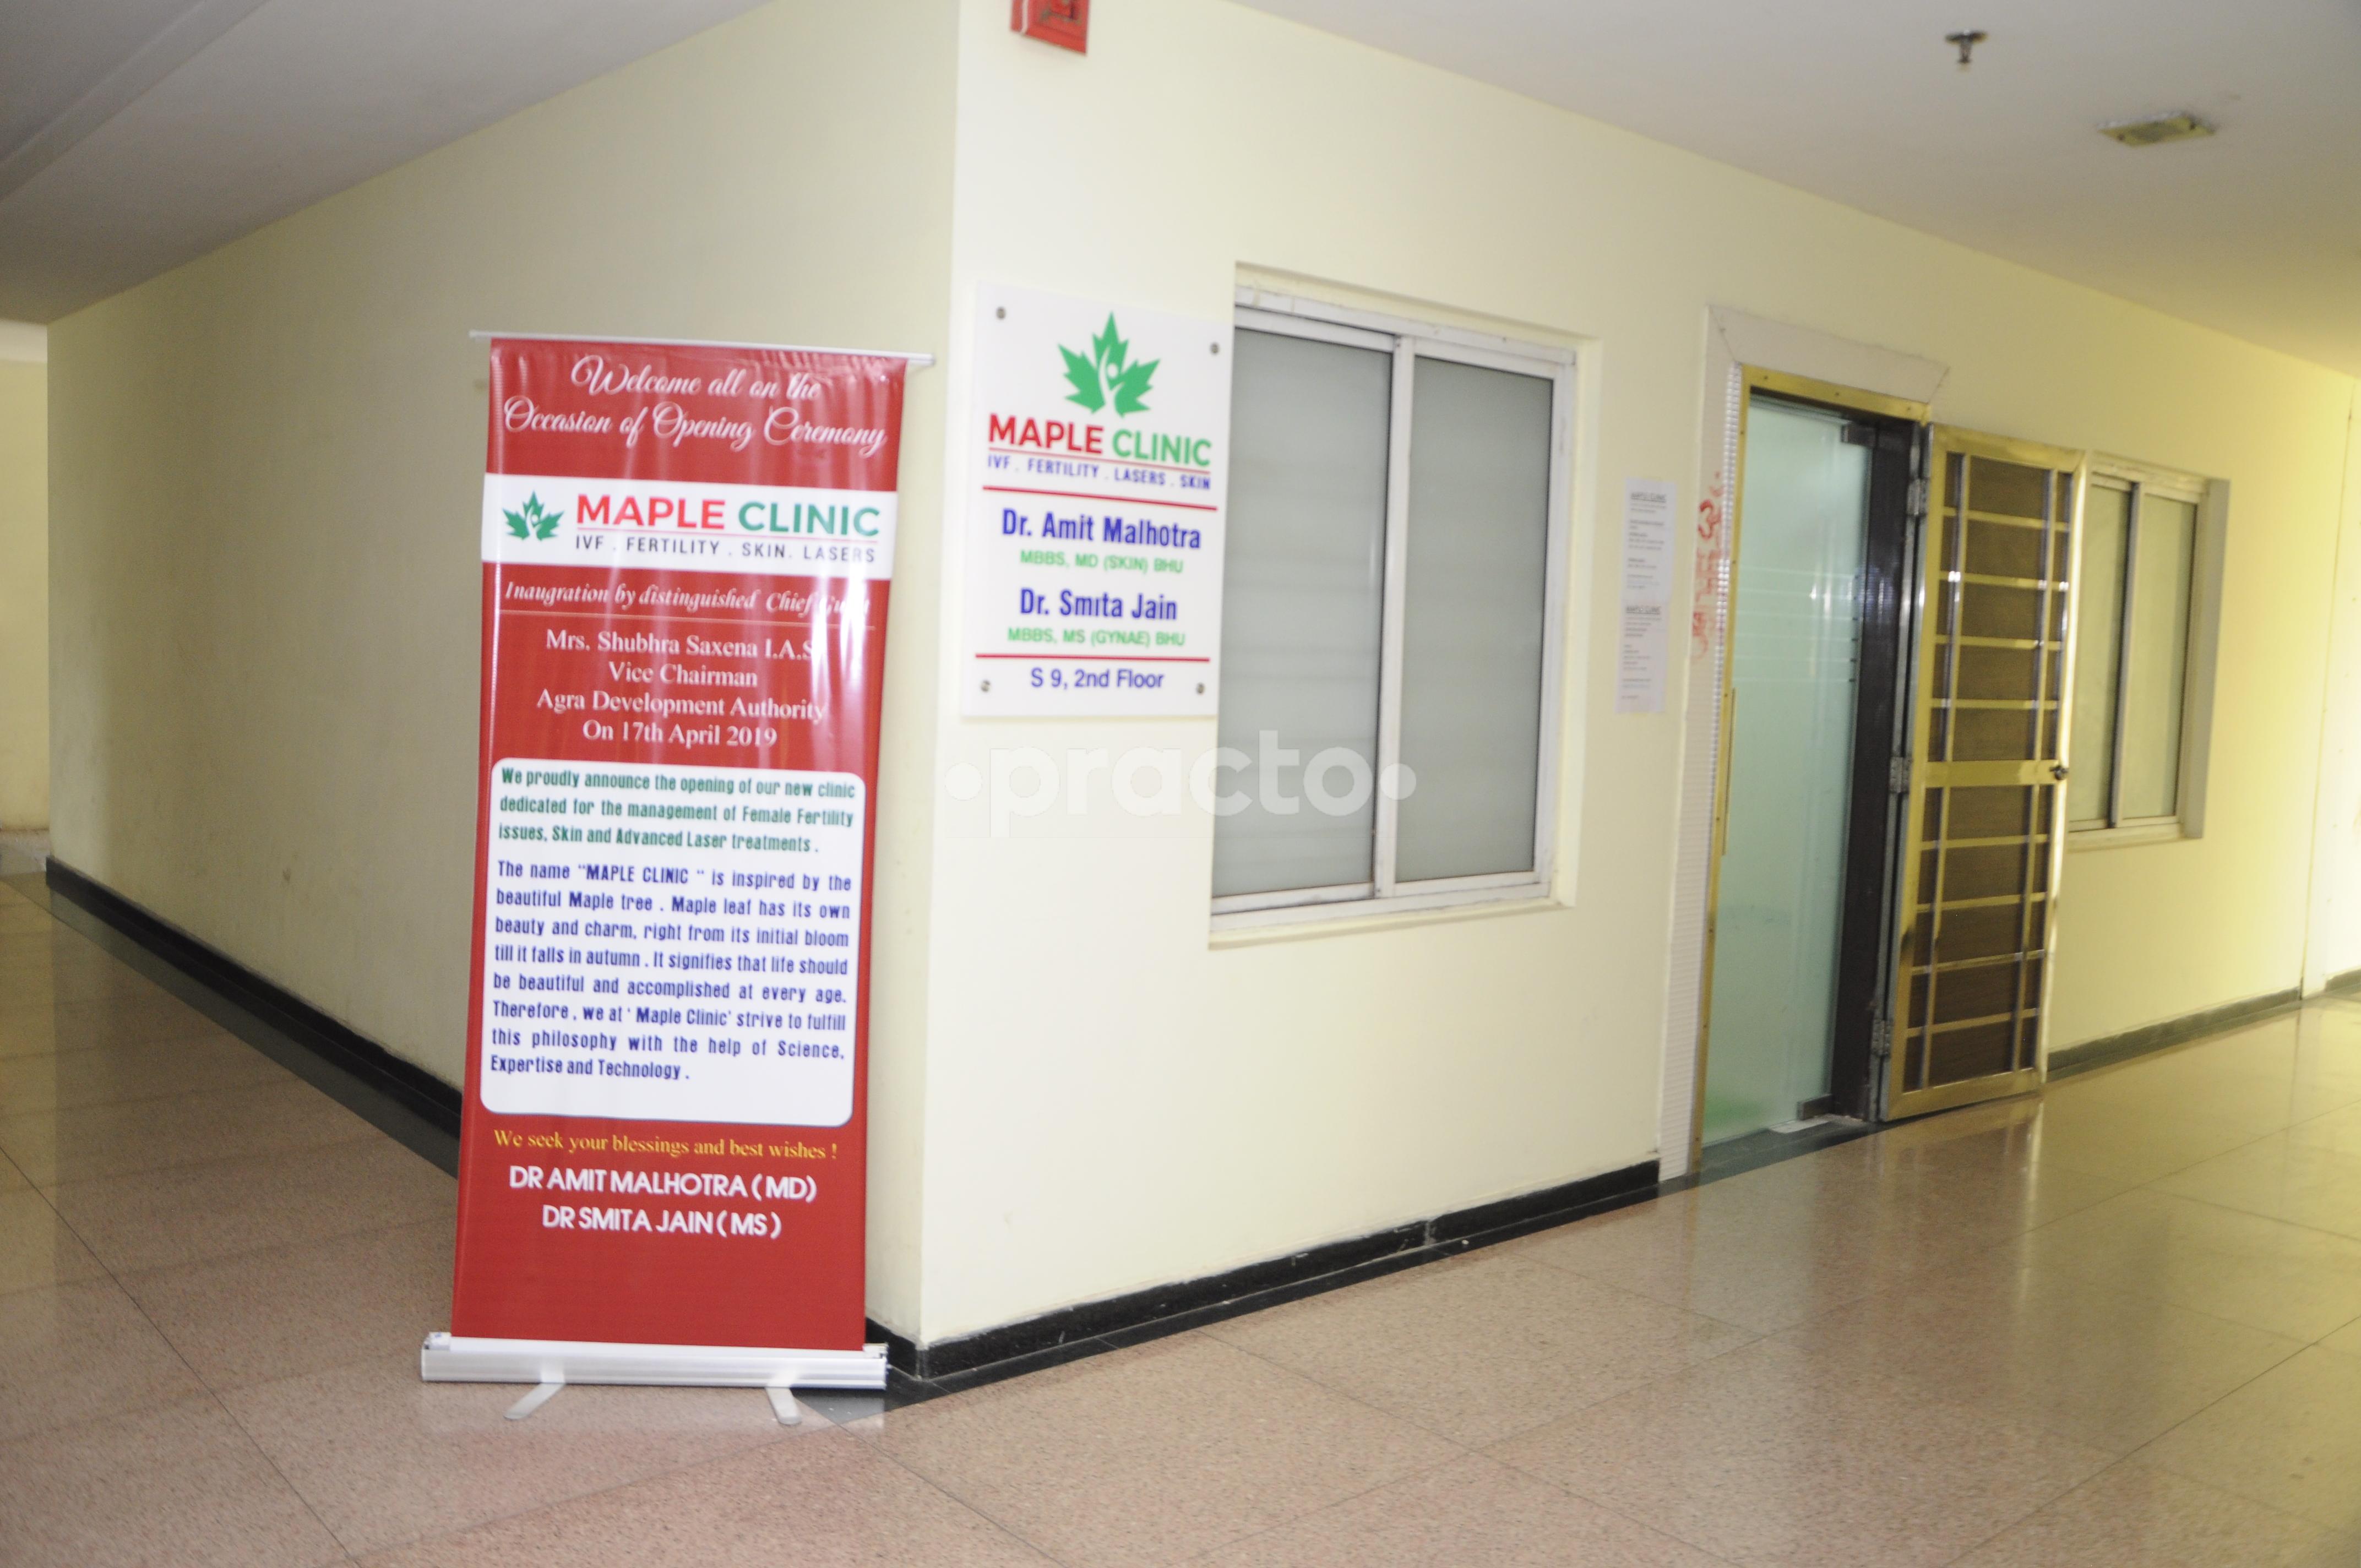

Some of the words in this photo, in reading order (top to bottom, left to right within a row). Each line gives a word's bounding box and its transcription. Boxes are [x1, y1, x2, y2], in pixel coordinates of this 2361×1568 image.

[571, 355, 701, 396] Welcome
[708, 369, 742, 396] all
[750, 378, 778, 397] on
[787, 373, 820, 400] the
[504, 395, 612, 434] Occasion
[620, 407, 646, 448] of
[652, 401, 754, 451] Opening
[763, 405, 888, 458] Ceremony
[988, 413, 1105, 454] MAPLE
[1112, 429, 1212, 466] CLINIC
[987, 455, 1011, 471] IVF
[1028, 458, 1100, 480] FERTILITY
[1114, 467, 1166, 486] LASERS
[1180, 473, 1211, 490] SKIN
[576, 494, 726, 530] MAPLE
[738, 502, 880, 537] CLINIC
[1002, 509, 1031, 537] Dr.
[1042, 512, 1095, 541] Amit
[1102, 516, 1202, 548] Malhotra
[575, 535, 604, 552] IVF
[627, 537, 719, 556] FERTILITY
[803, 546, 875, 563] LASERS
[1075, 554, 1098, 568] MD
[1104, 555, 1149, 574] (SKIN)
[1154, 558, 1183, 573] BHU
[505, 582, 609, 608] Inaugration
[614, 584, 637, 609] by
[639, 585, 757, 609] distinguished
[766, 590, 813, 615] Chief
[1020, 589, 1049, 615] Dr.
[1131, 593, 1177, 620] Jain
[546, 630, 590, 651] Mrs.
[597, 632, 680, 654] Shubhra
[686, 635, 757, 657] Saxena
[1063, 629, 1086, 643] MS
[1156, 632, 1185, 646] BHU
[609, 662, 653, 683] Vice
[660, 663, 757, 687] Chairman
[1031, 668, 1044, 688] S
[1074, 669, 1109, 688] 2nd
[1117, 669, 1164, 689] Floor
[537, 690, 585, 715] Agra
[592, 692, 725, 716] Development
[731, 698, 826, 723] Authority
[583, 720, 613, 740] On
[623, 722, 662, 742] 17th
[669, 725, 720, 748] April
[727, 727, 776, 747] 2019
[502, 767, 522, 784] We
[526, 770, 579, 788] proudly
[585, 774, 650, 790] announce
[655, 775, 676, 791] the
[681, 778, 734, 794] opening
[739, 778, 752, 793] of
[757, 782, 780, 794] our
[785, 783, 813, 796] new
[819, 783, 855, 798] clinic
[500, 796, 567, 814] dedicated
[574, 798, 594, 814] for
[602, 800, 622, 816] the
[628, 804, 717, 820] management
[723, 806, 736, 820] of
[743, 806, 791, 823] Female
[798, 809, 853, 827] Fertility
[552, 825, 582, 842] Skin
[587, 828, 611, 843] and
[616, 828, 683, 846] Advanced
[687, 831, 727, 848] Laser
[732, 834, 810, 852] treatments
[498, 860, 523, 877] The
[530, 864, 570, 879] name
[643, 867, 688, 884] CLINIC
[712, 870, 724, 886] is
[732, 872, 795, 890] inspired
[803, 874, 819, 891] by
[829, 875, 851, 891] the
[496, 888, 561, 907] beautiful
[569, 891, 613, 911] Maple
[621, 894, 652, 911] tree
[672, 896, 716, 916] Maple
[724, 899, 751, 914] leaf
[759, 900, 785, 916] has
[793, 902, 811, 917] its
[820, 905, 850, 918] own
[496, 916, 545, 936] beauty
[552, 919, 578, 935] and
[644, 924, 681, 941] right
[689, 925, 724, 941] from
[731, 928, 749, 943] its
[757, 929, 798, 945] initial
[805, 930, 848, 946] bloom
[495, 945, 513, 961] till
[518, 945, 527, 962] it
[532, 946, 564, 963] falls
[569, 948, 581, 963] in
[586, 950, 640, 967] autumn
[654, 951, 663, 967] It
[668, 954, 732, 970] signifies
[738, 955, 766, 972] that
[771, 957, 794, 973] life
[799, 959, 847, 974] should
[493, 972, 510, 989] be
[519, 973, 584, 992] beautiful
[593, 978, 619, 994] and
[627, 981, 730, 999] accomplished
[739, 984, 752, 999] at
[762, 987, 806, 1003] every
[493, 1000, 568, 1019] Therefore
[583, 1007, 604, 1021] we
[609, 1006, 622, 1022] at
[636, 1007, 681, 1026] Maple
[737, 1012, 782, 1028] strive
[788, 1014, 802, 1029] to
[808, 1014, 845, 1030] fulfill
[492, 1028, 520, 1046] this
[532, 1030, 617, 1051] philosophy
[628, 1035, 662, 1051] with
[674, 1036, 698, 1053] the
[709, 1037, 741, 1057] help
[752, 1039, 766, 1055] of
[491, 1054, 563, 1074] Expertise
[567, 1059, 592, 1075] and
[599, 1059, 681, 1080] Technology
[494, 1130, 522, 1147] We
[528, 1132, 563, 1148] seek
[569, 1136, 608, 1153] your
[613, 1135, 689, 1156] blessings
[694, 1139, 724, 1156] and
[730, 1140, 764, 1157] best
[769, 1141, 825, 1158] wishes
[509, 1166, 543, 1188] DR
[547, 1168, 608, 1192] AMIT
[611, 1170, 747, 1197] MALHOTRA
[543, 1205, 574, 1229] DR
[578, 1207, 656, 1231] SMITA
[657, 1211, 714, 1234] JAIN
